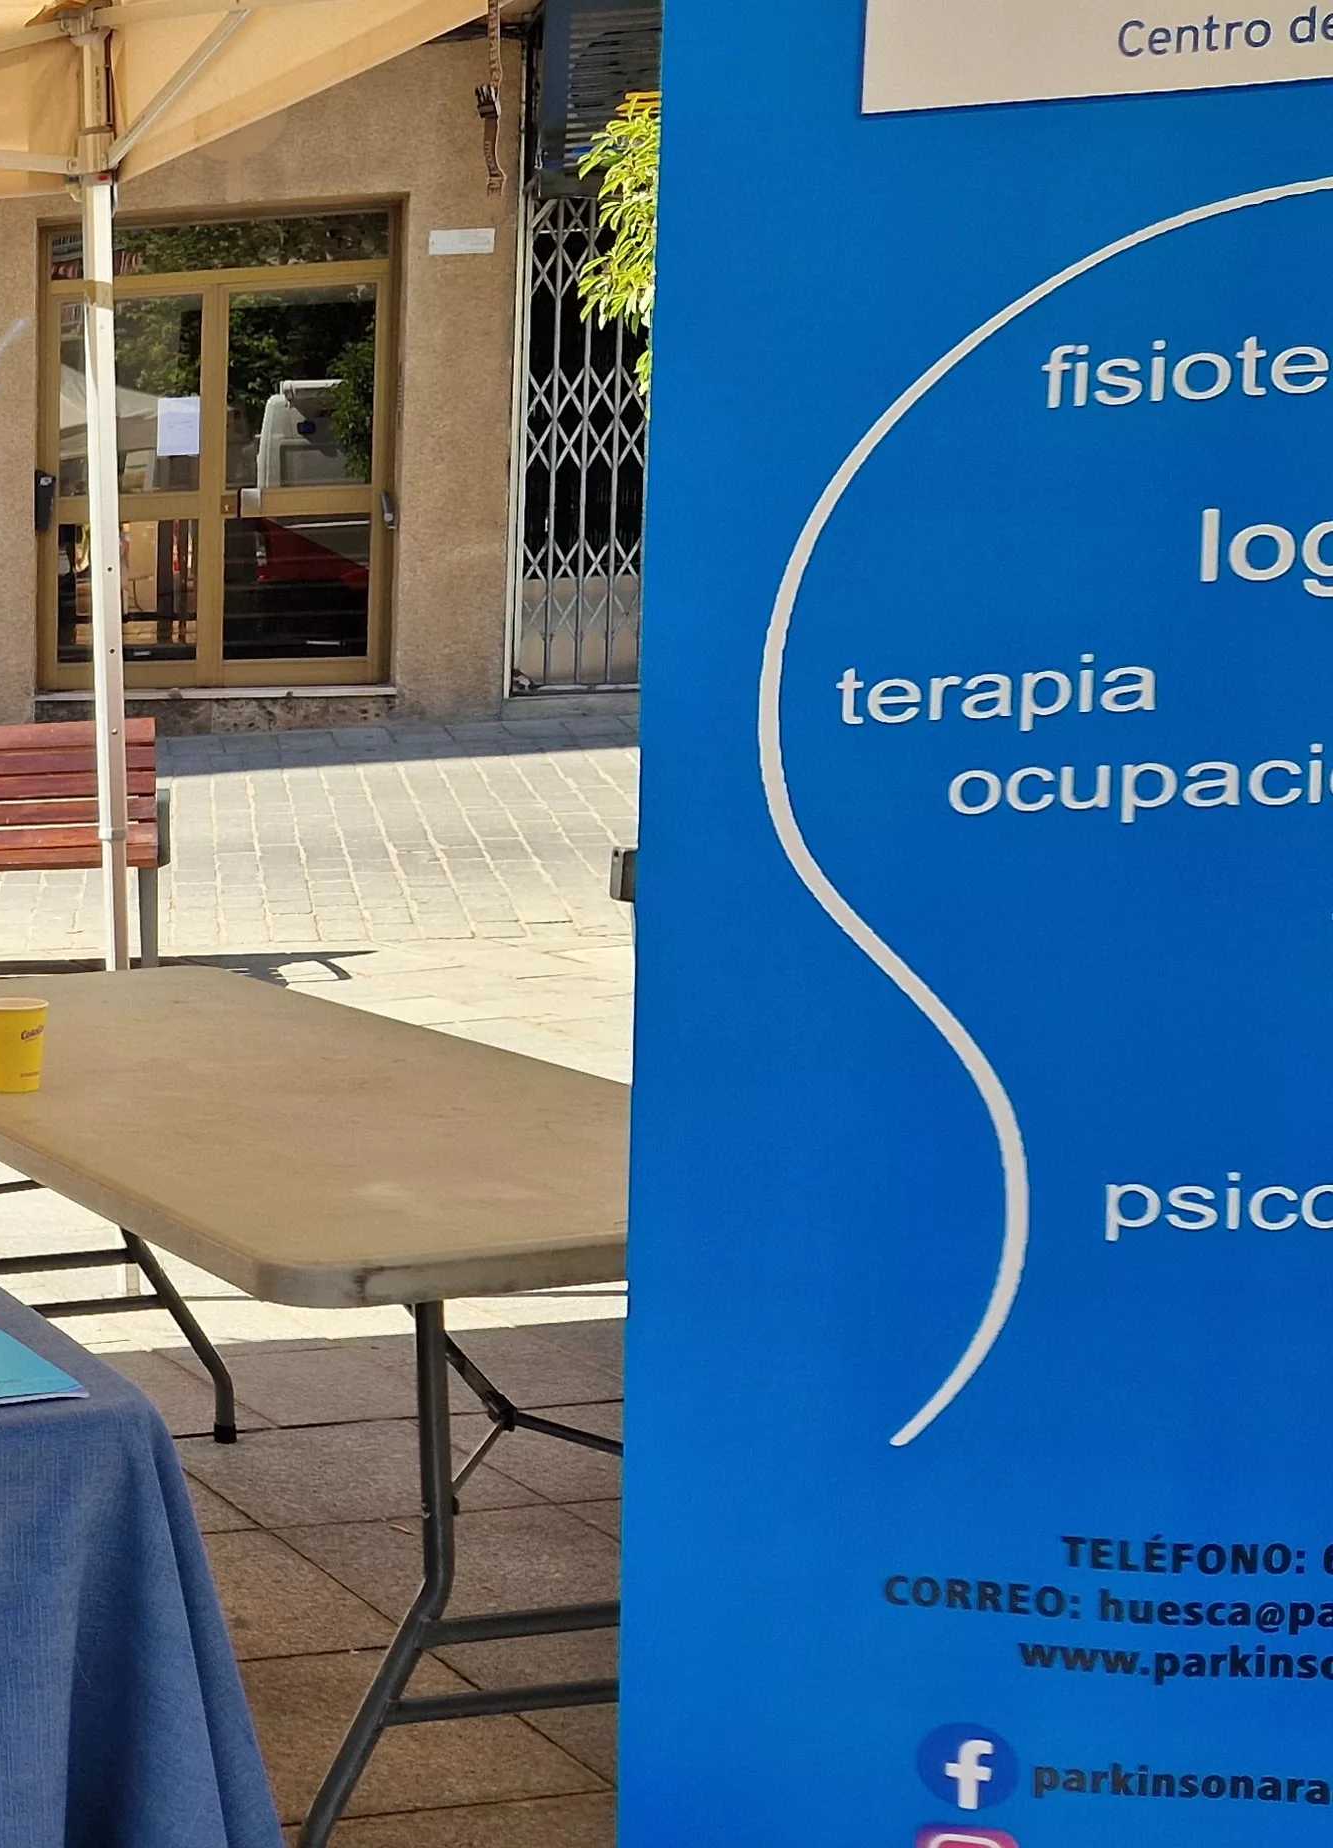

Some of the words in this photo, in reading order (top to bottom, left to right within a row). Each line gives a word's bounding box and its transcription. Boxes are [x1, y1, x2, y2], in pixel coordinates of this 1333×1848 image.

[1118, 14, 1273, 58] Centro
[1042, 336, 1329, 409] fisiote
[836, 654, 1156, 732] terapia
[947, 744, 1333, 823] ocupaci
[1062, 1534, 1306, 1576] TELÉFONO:
[882, 1574, 1082, 1620] CORREO:
[1099, 1588, 1333, 1636] huesca@pa
[1033, 1761, 1332, 1807] parkinsonara
